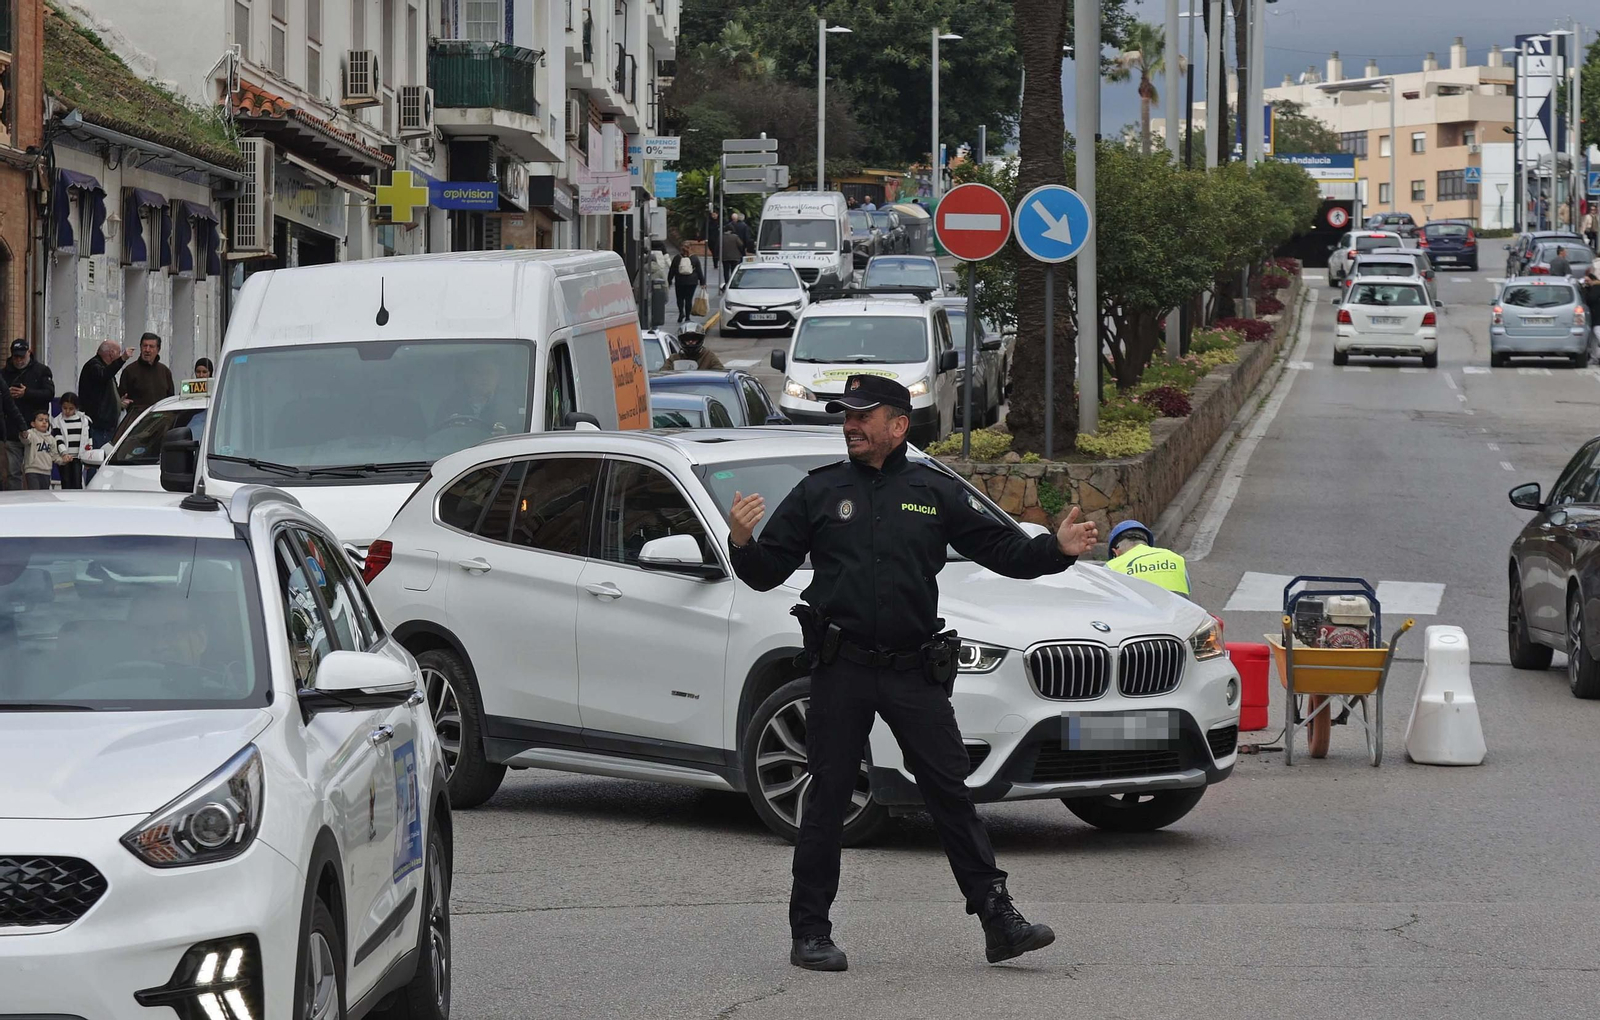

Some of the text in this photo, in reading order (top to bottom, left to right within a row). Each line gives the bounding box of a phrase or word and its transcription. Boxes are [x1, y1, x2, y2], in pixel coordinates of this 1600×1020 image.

[646, 146, 663, 154] 0%
[190, 382, 208, 392] TAXI
[901, 502, 938, 516] POLICIA
[1126, 560, 1177, 576] albaida
